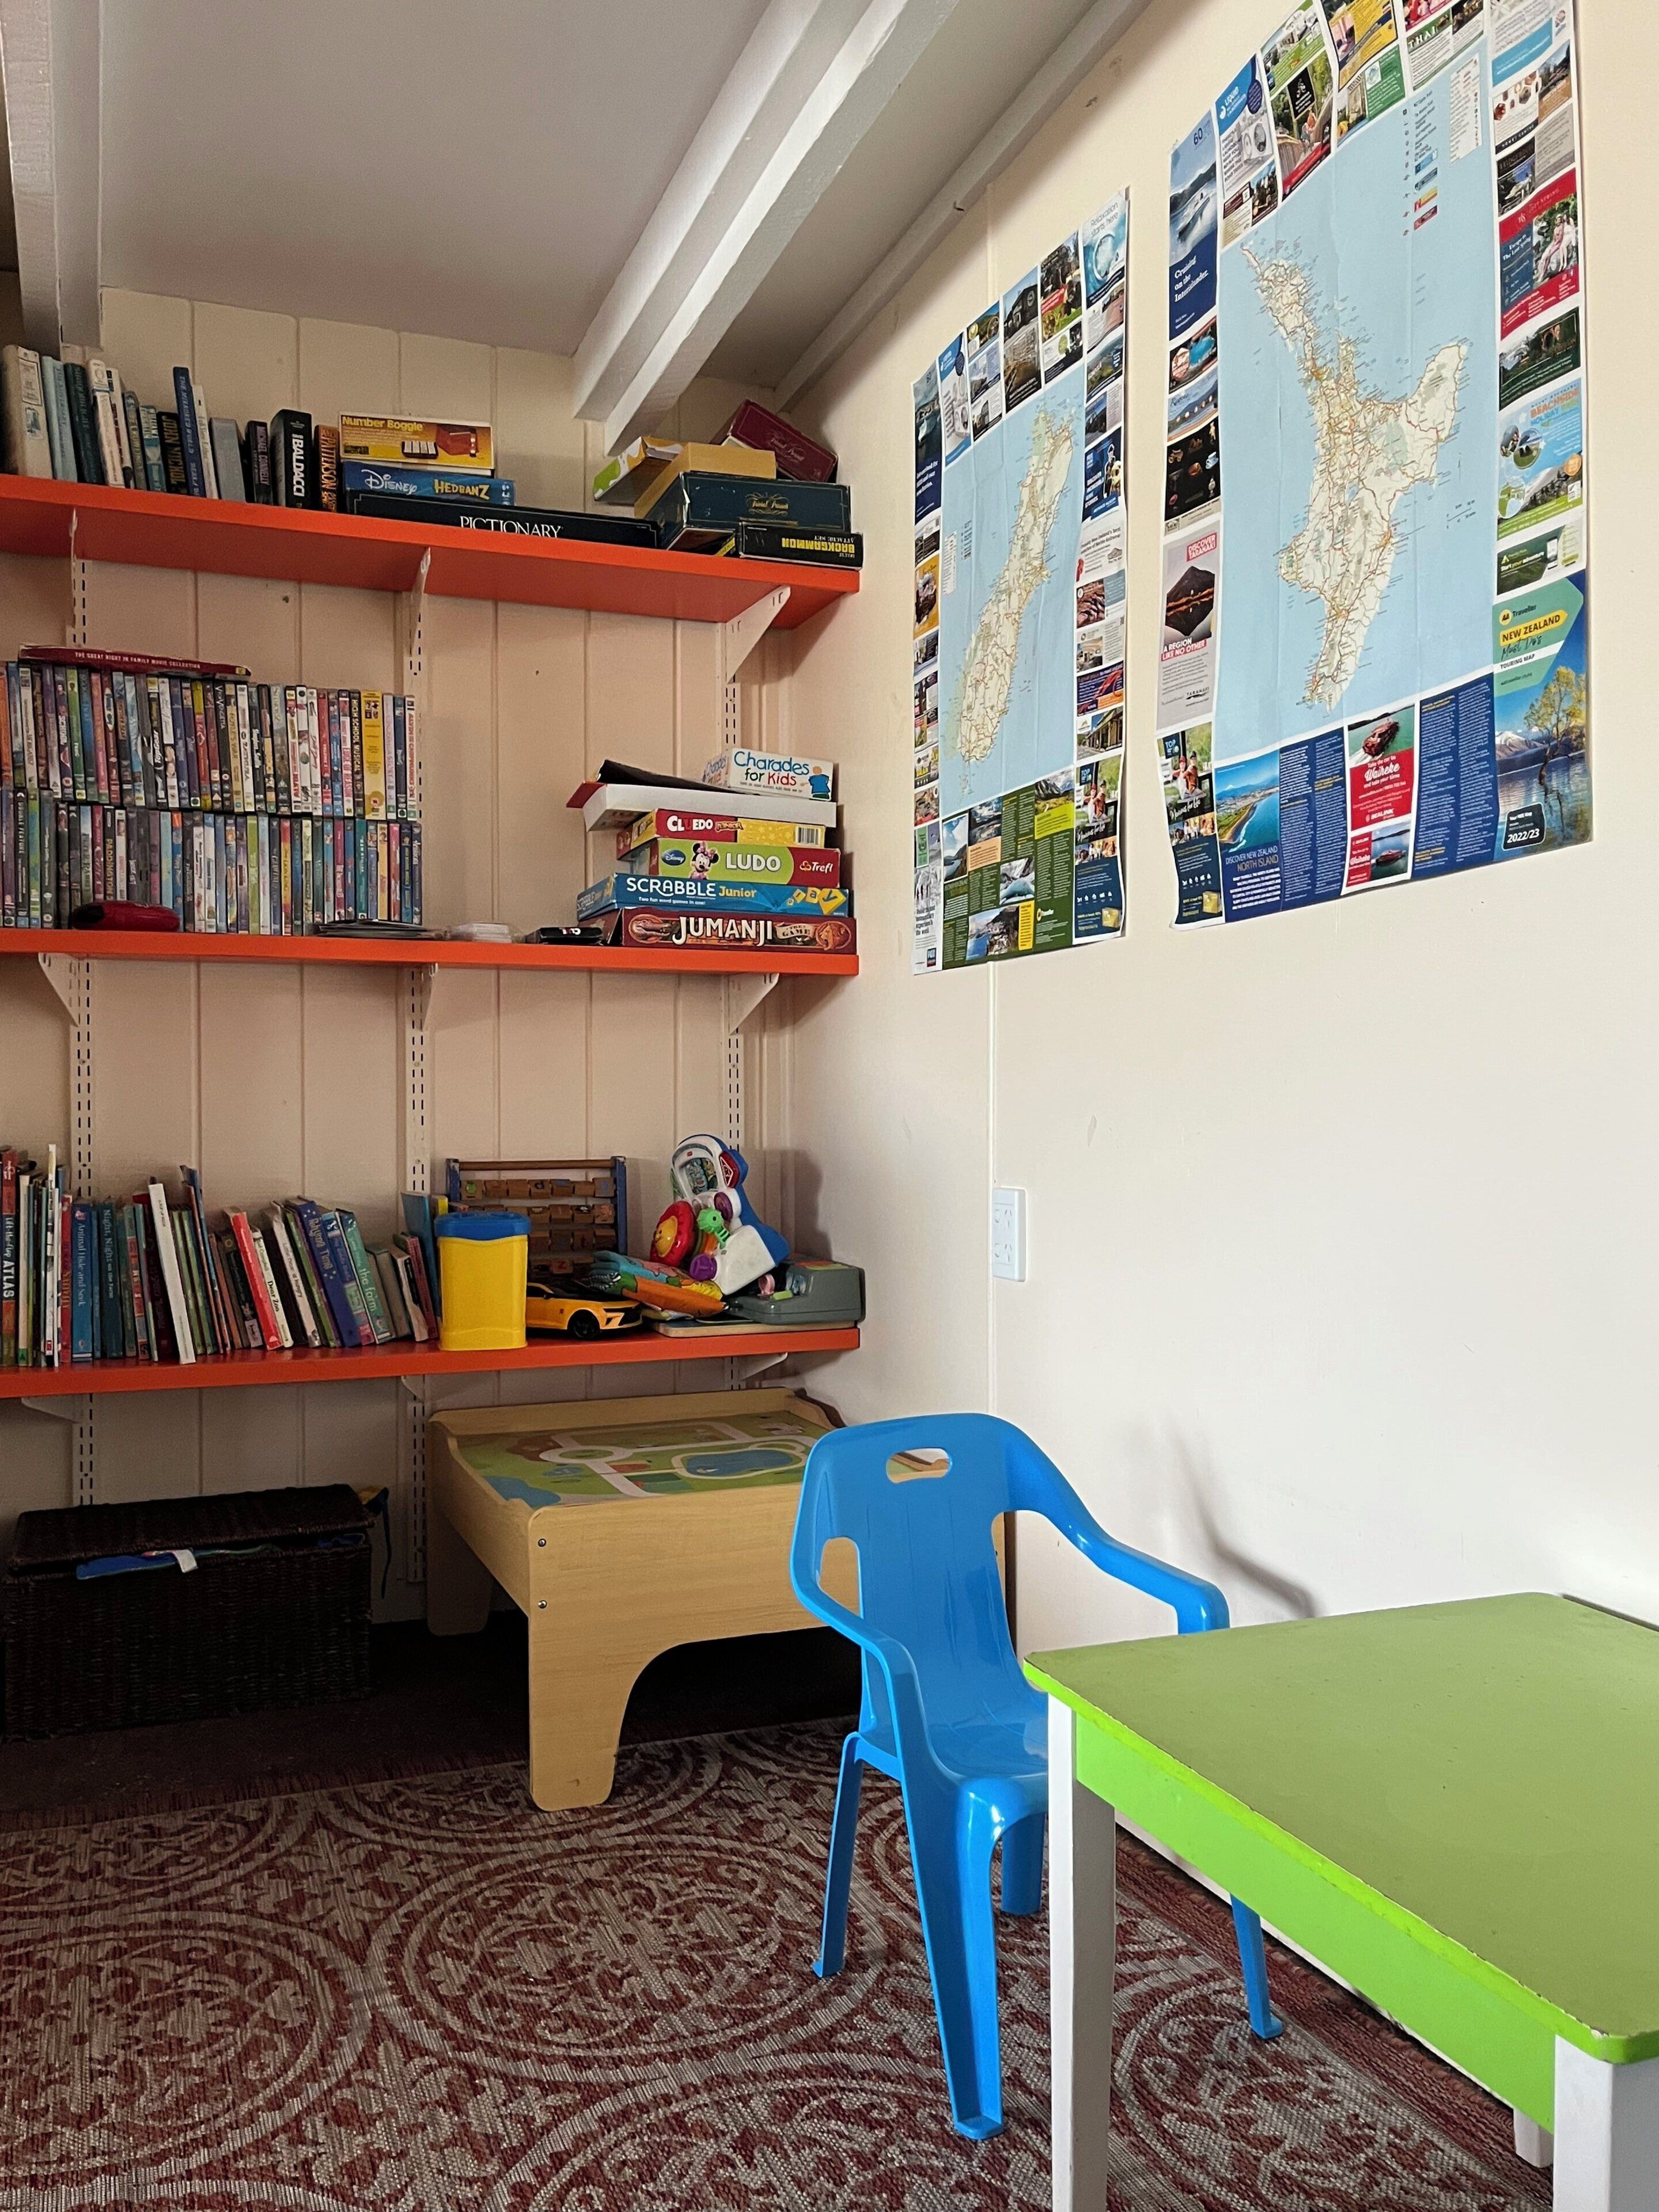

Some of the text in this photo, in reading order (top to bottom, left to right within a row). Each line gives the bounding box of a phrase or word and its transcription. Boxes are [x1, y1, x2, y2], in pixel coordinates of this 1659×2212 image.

[1408, 24, 1437, 48] THAI
[1193, 127, 1203, 145] 60
[1090, 202, 1118, 227] Relaxation
[342, 416, 423, 432] Number Boggle
[257, 426, 270, 486] MICHAEL CONNELLY
[320, 435, 338, 490] PATTERSON
[291, 438, 305, 497] BALDACCI
[460, 516, 562, 539] PICTIONARY
[782, 537, 855, 553] BACKGAMMON
[1187, 534, 1215, 551] DISCOVER
[1501, 604, 1537, 622] AA Traveller
[1502, 614, 1560, 642] NEW ZEALAND
[1162, 639, 1206, 659] LIKE NO OTHER
[1168, 637, 1192, 650] REGION
[1501, 638, 1521, 660] Must
[1501, 653, 1535, 669] TOURING MAP
[351, 718, 359, 744] SCHOOL
[1165, 738, 1176, 750] TOP
[352, 744, 361, 772] MUSICAL
[734, 751, 810, 775] Charades
[745, 767, 797, 786] for Kids
[1081, 768, 1090, 777] TOP
[1364, 762, 1400, 782] Waiheke
[666, 815, 744, 832] CLUEDO JUNIOR
[1507, 828, 1540, 843] 2022/23
[105, 838, 114, 893] PADDINGTON
[726, 853, 781, 872] LUDO
[810, 861, 833, 873] Trefl
[1225, 845, 1278, 865] DISCOVER NEW ZEALAND
[1237, 854, 1279, 872] NORTH ISLAND
[1349, 854, 1371, 866] Waiheke
[627, 877, 757, 898] SCRABBLE Junior
[672, 916, 772, 947] JUMANJI
[782, 929, 811, 937] GAME
[103, 1209, 111, 1234] Night,
[76, 1222, 86, 1251] Animal
[307, 1218, 333, 1270] Rhyme Time
[104, 1237, 112, 1262] Night
[2, 1260, 16, 1298] ATLAS
[359, 1268, 380, 1311] the farm
[267, 1281, 276, 1298] Dear
[273, 1298, 281, 1313] Zoo
